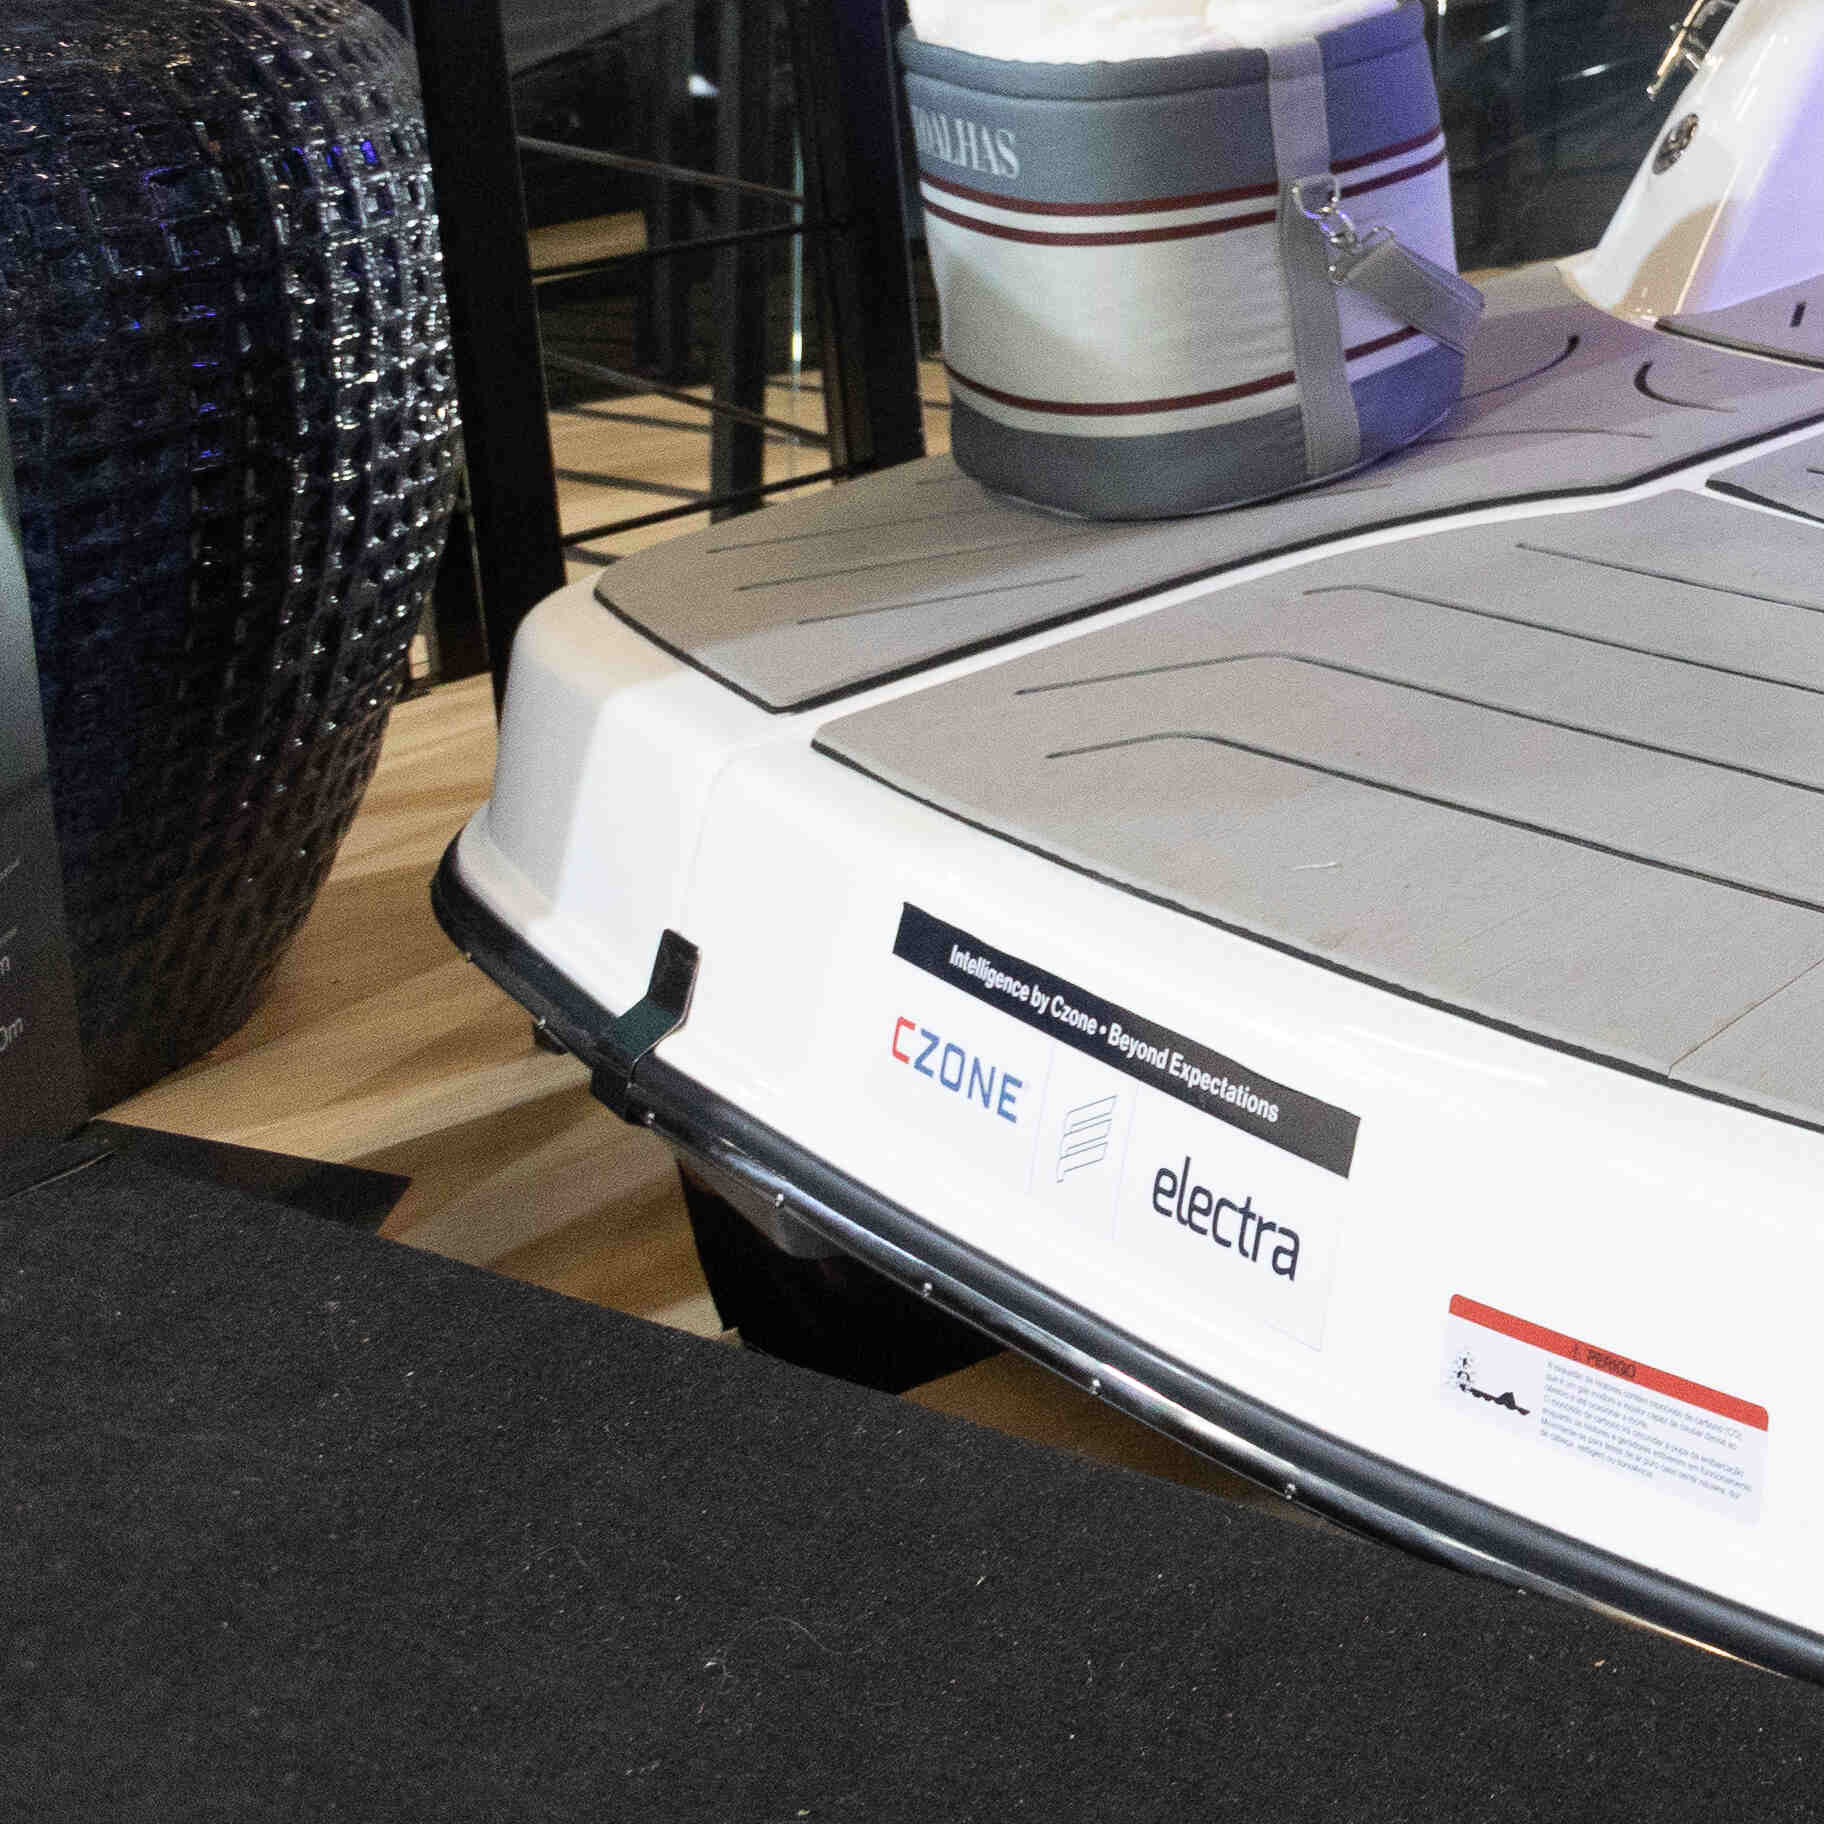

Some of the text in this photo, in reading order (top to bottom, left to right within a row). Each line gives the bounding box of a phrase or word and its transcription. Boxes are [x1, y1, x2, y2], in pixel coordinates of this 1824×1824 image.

[891, 1016, 1023, 1124] CZONE
[949, 944, 1279, 1123] Intelligence by Czone Beyond Expectations
[1152, 1155, 1301, 1281] electra
[1586, 1348, 1638, 1379] PERIGO
